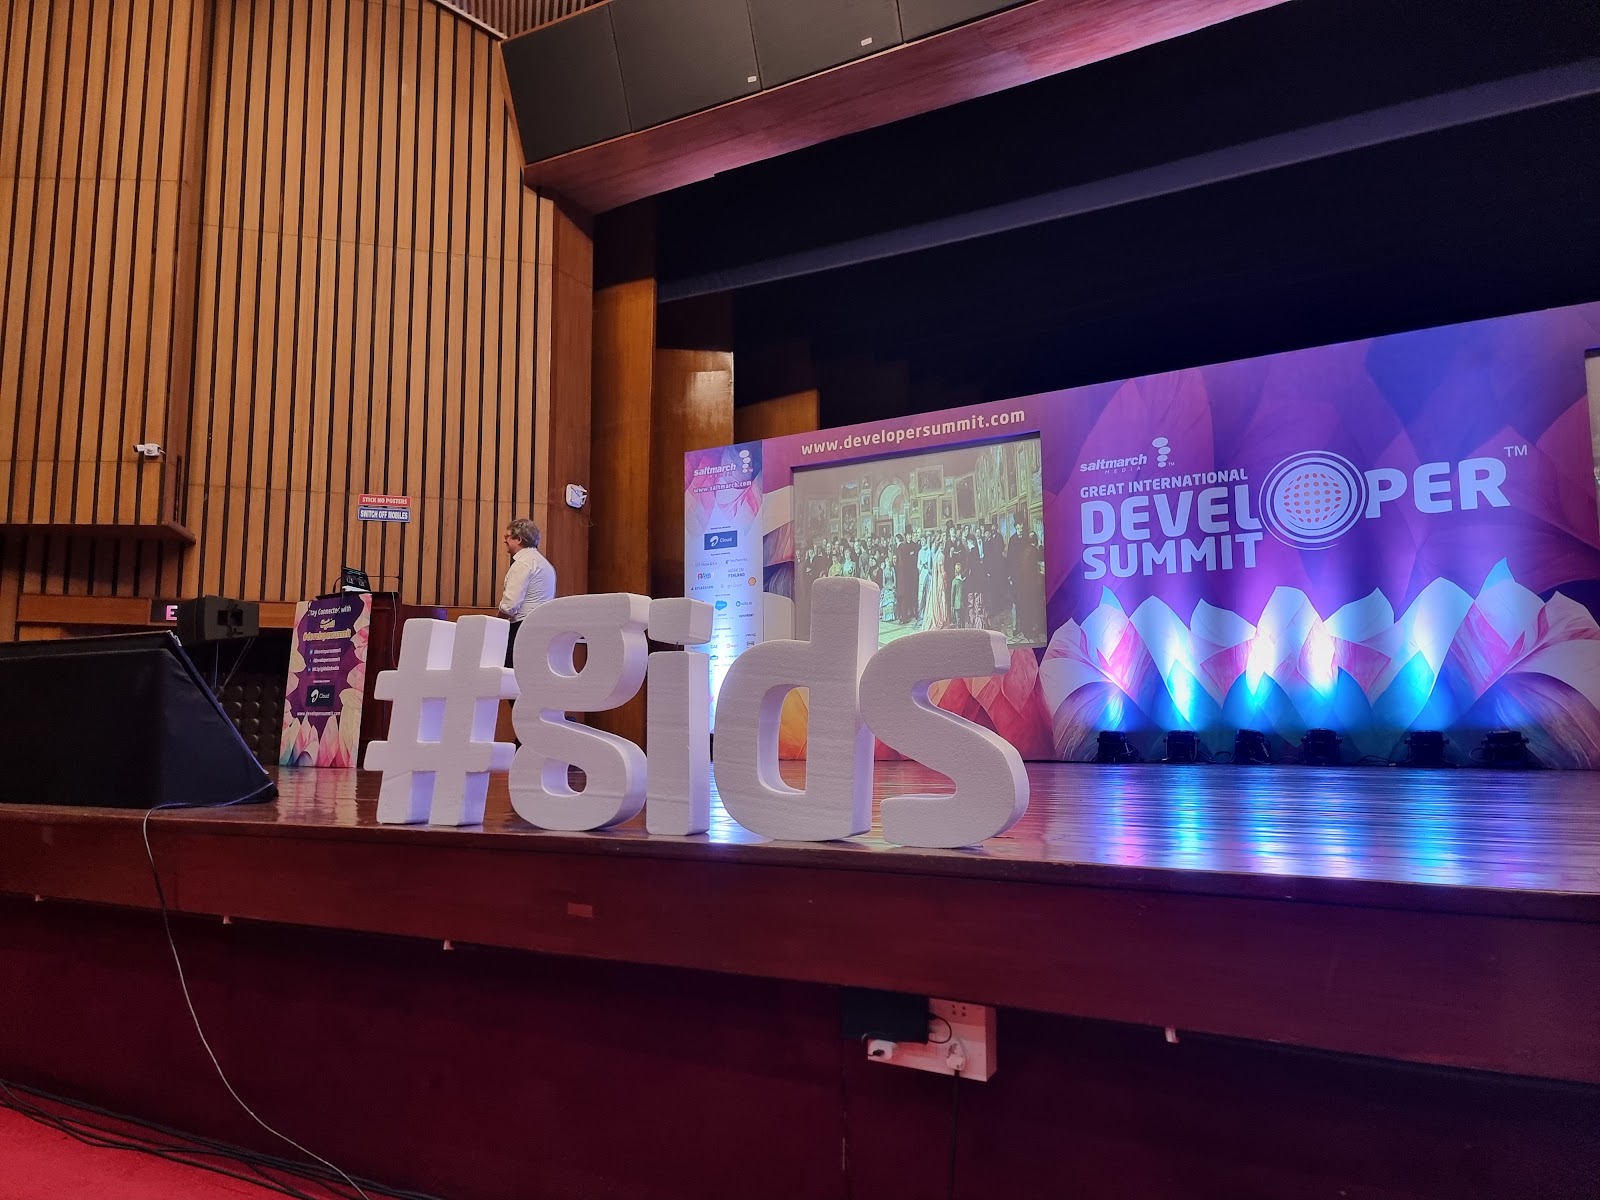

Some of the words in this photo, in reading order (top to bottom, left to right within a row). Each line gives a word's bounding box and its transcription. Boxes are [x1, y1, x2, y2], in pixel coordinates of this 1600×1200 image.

[801, 410, 1025, 455] www.developersummit.com
[693, 463, 736, 477] saltmarch
[1080, 454, 1147, 472] saltmarch
[1104, 466, 1141, 475] MEDIA
[693, 481, 752, 493] www.saltmarch.com
[1080, 483, 1124, 498] GREAT
[1128, 468, 1248, 493] INTERNATIONAL
[360, 509, 378, 518] SWITCH
[378, 510, 388, 518] OFF
[388, 511, 408, 520] MOBILES
[1082, 531, 1263, 580] SUMMIT
[341, 604, 352, 613] with
[363, 577, 1029, 848] #gids
